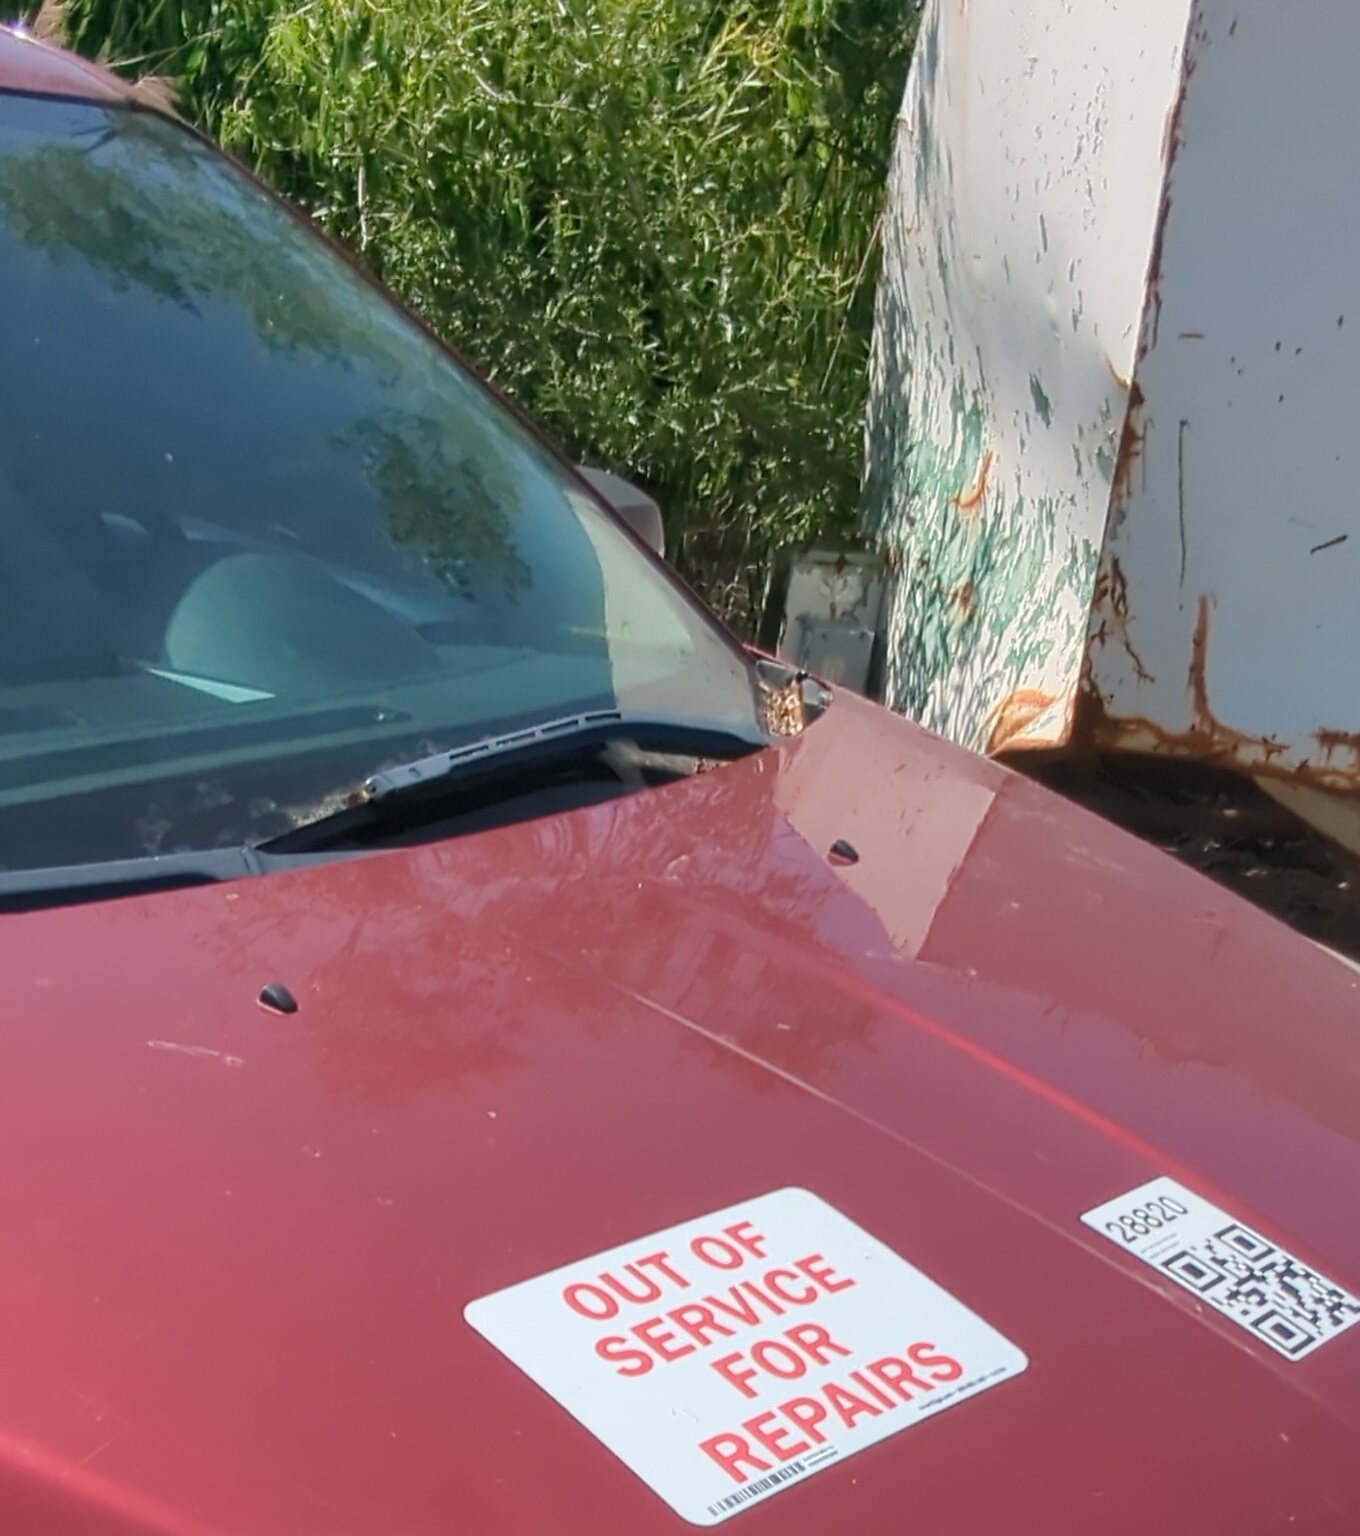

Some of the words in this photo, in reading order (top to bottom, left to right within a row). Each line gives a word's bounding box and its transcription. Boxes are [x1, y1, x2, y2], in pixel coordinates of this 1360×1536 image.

[1105, 1196, 1188, 1243] 28820
[562, 1250, 691, 1321] OUT
[690, 1220, 767, 1271] OF
[595, 1253, 856, 1377] SERVICE
[711, 1321, 853, 1399] FOR
[700, 1341, 964, 1483] REPAIRS
